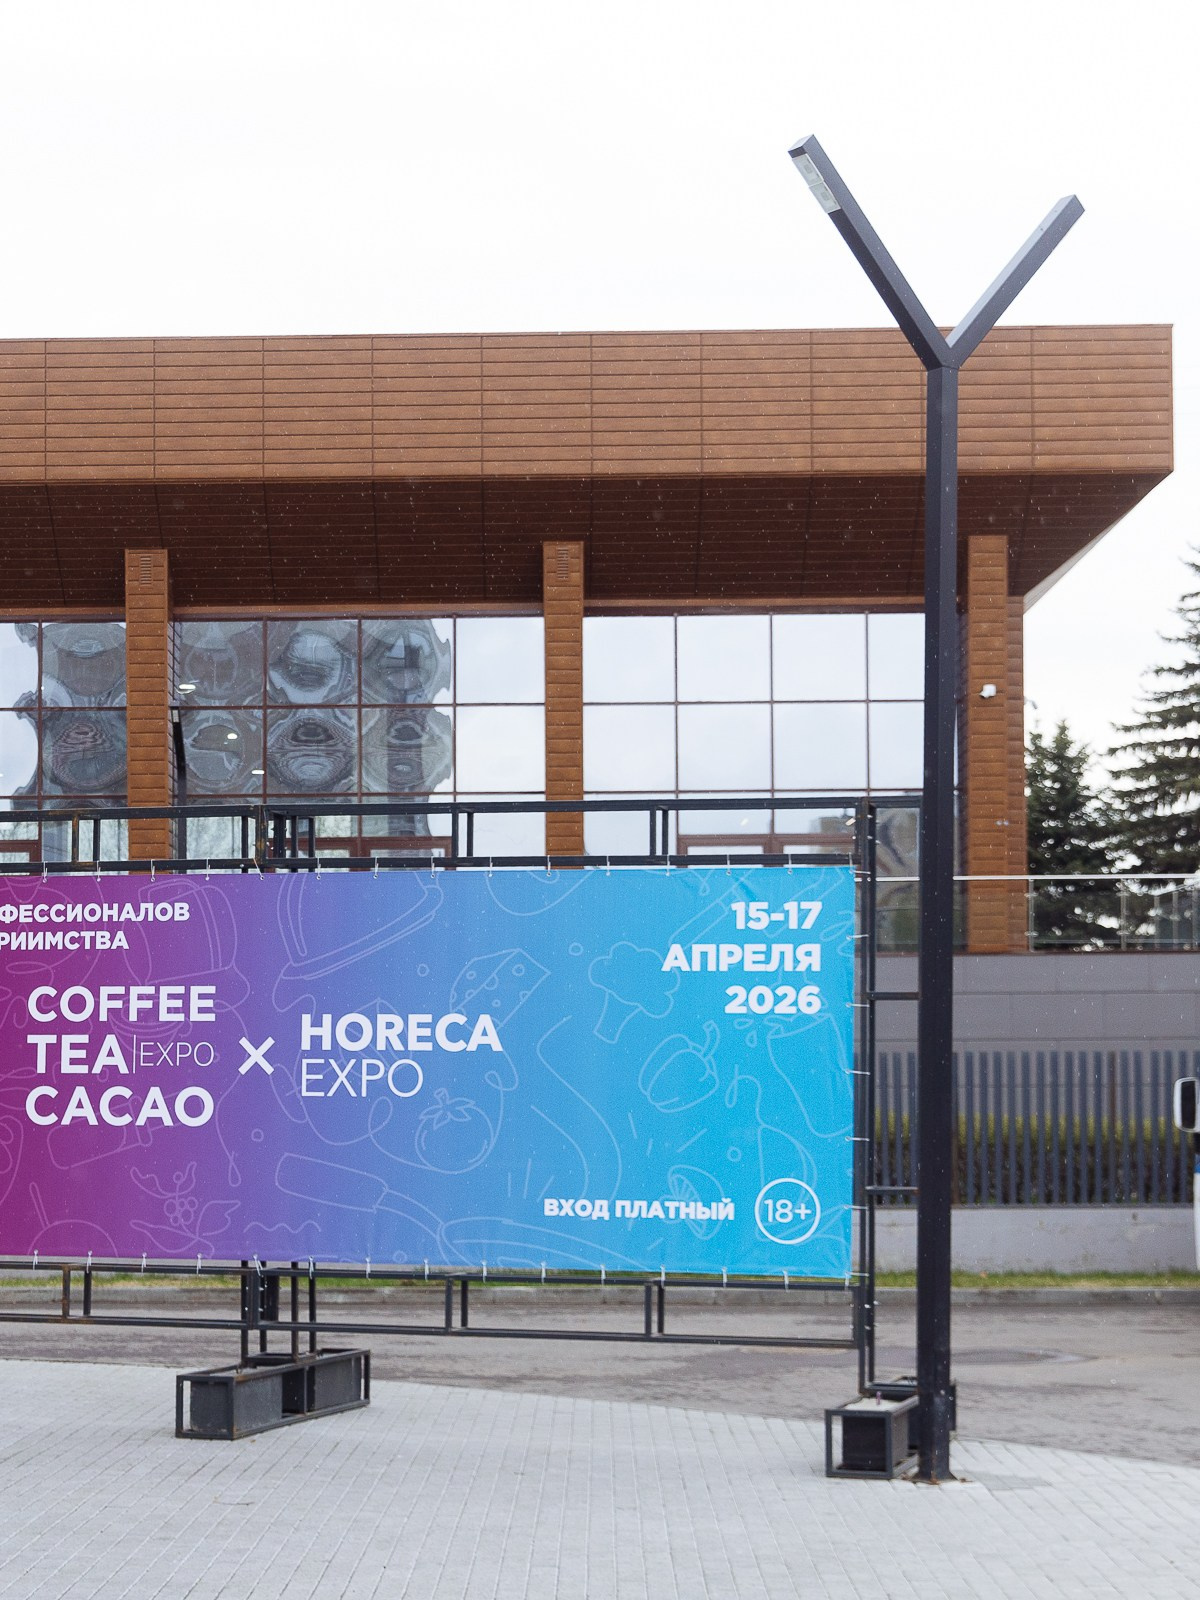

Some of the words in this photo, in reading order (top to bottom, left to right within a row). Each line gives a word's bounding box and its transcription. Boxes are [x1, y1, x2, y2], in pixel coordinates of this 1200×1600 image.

[731, 901, 822, 930] 15-17
[662, 943, 821, 972] АПРЕЛЯ
[27, 985, 217, 1023] COFFEE
[725, 985, 821, 1014] 2026
[301, 1013, 503, 1053] HORECA
[26, 1034, 129, 1074] TEA
[140, 1041, 215, 1067] EXPO
[301, 1058, 424, 1098] EXPO
[25, 1085, 215, 1127] CACAO
[544, 1198, 610, 1220] ВХОД
[615, 1197, 735, 1221] ПЛАТНЫЙ
[763, 1198, 813, 1224] 18+
